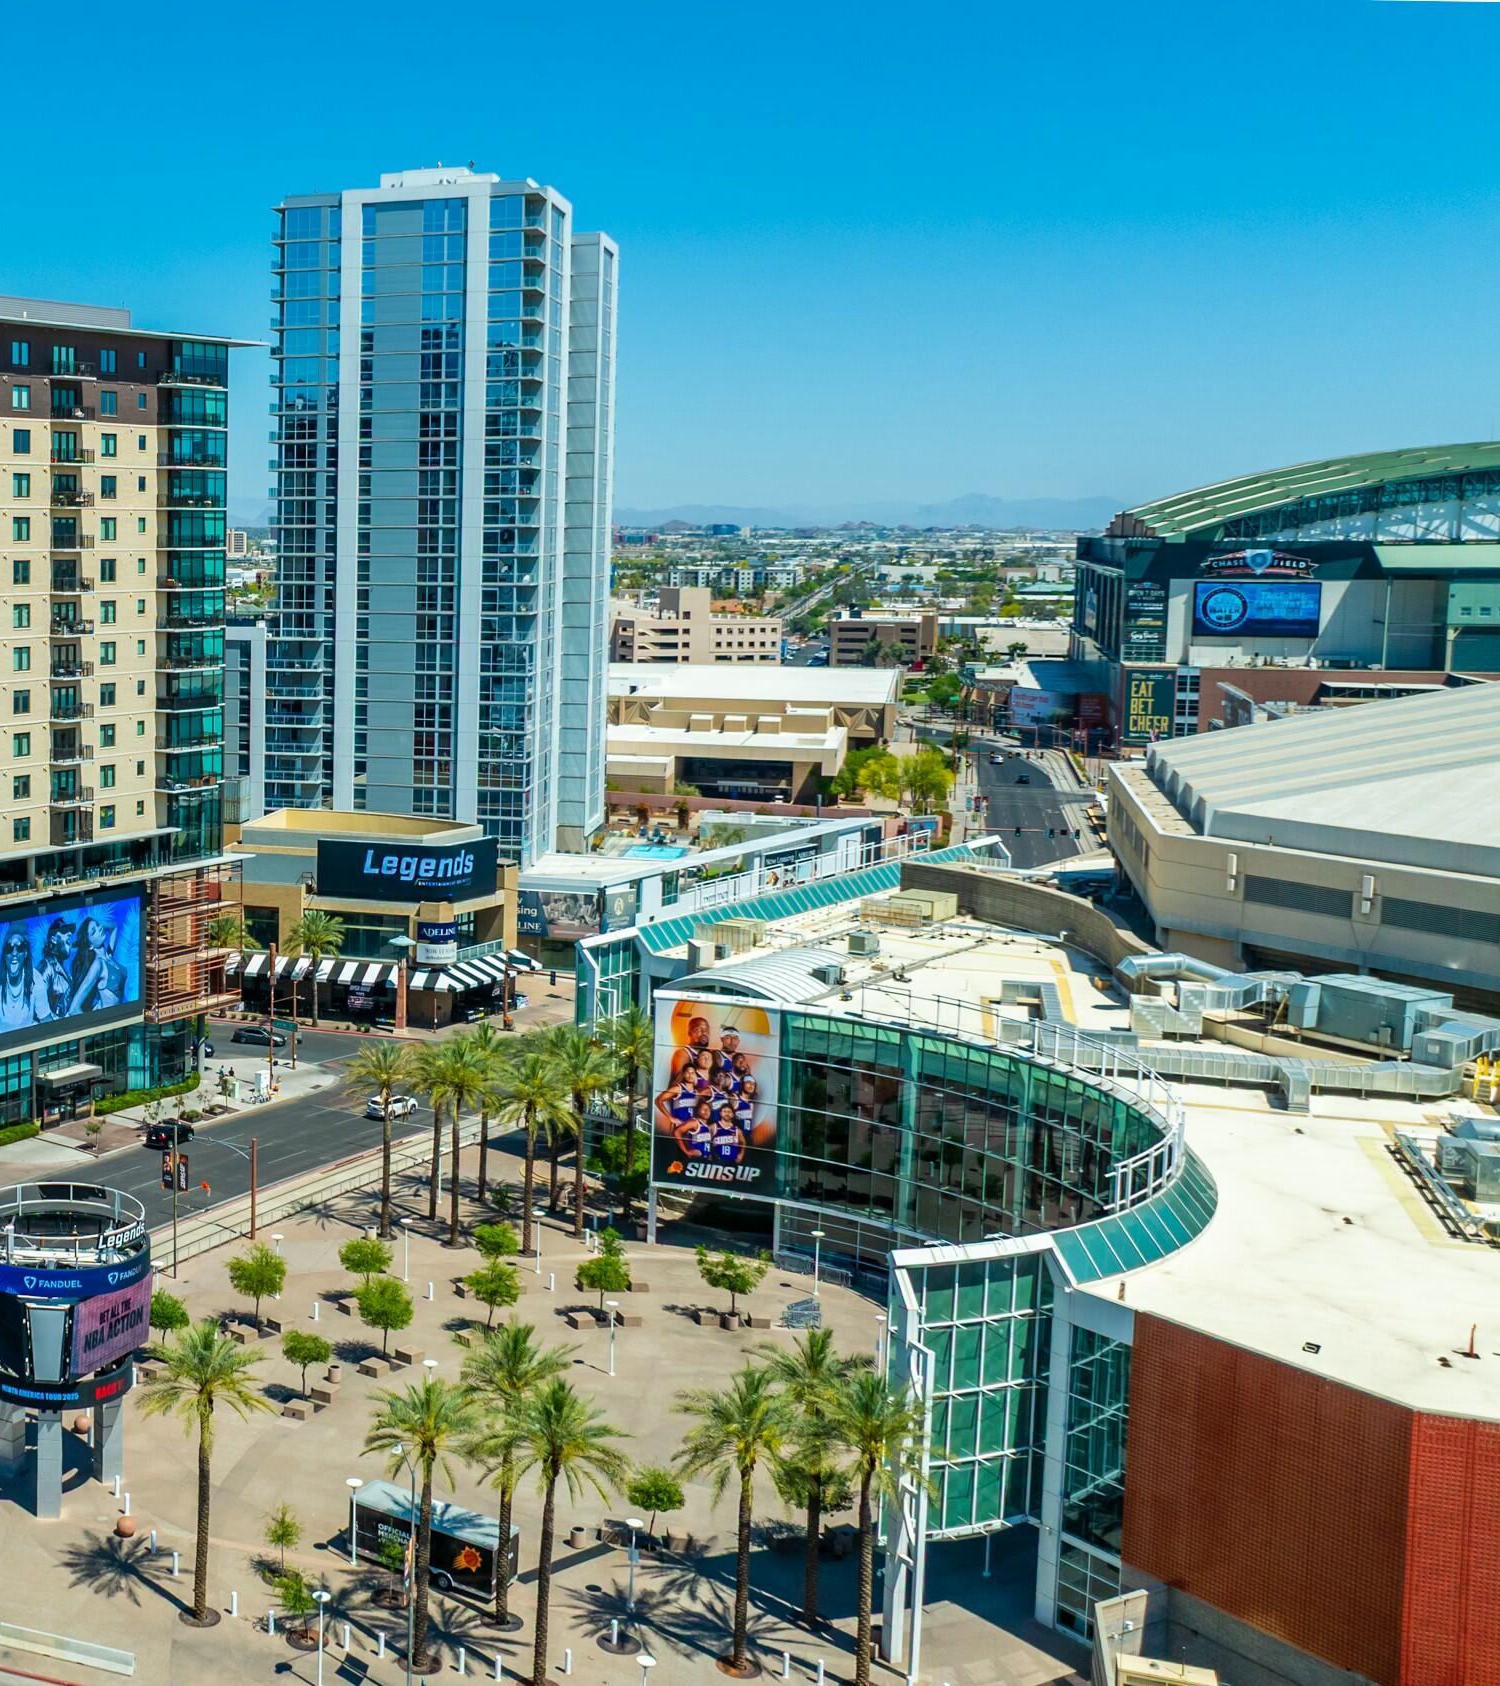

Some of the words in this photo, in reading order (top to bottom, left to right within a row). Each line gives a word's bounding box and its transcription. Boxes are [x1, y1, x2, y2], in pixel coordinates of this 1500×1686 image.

[1212, 559, 1244, 568] CHASE
[1273, 560, 1306, 568] FIELD
[1131, 681, 1155, 697] EAT
[1130, 698, 1155, 714] BET
[1129, 715, 1169, 732] CHEER
[363, 849, 474, 881] Legends
[721, 1145, 731, 1155] 18
[685, 1162, 736, 1181] SUNS
[735, 1165, 761, 1181] UP
[98, 1222, 146, 1250] Legends
[119, 1266, 142, 1281] FANDU
[38, 1279, 82, 1288] FANDUEL
[100, 1309, 110, 1326] BET
[110, 1301, 120, 1319] ALL
[121, 1297, 131, 1314] THE
[84, 1325, 105, 1354] NBA
[107, 1305, 143, 1342] ACTION
[62, 1392, 79, 1400] 2025
[378, 1522, 410, 1539] OFFICIAL
